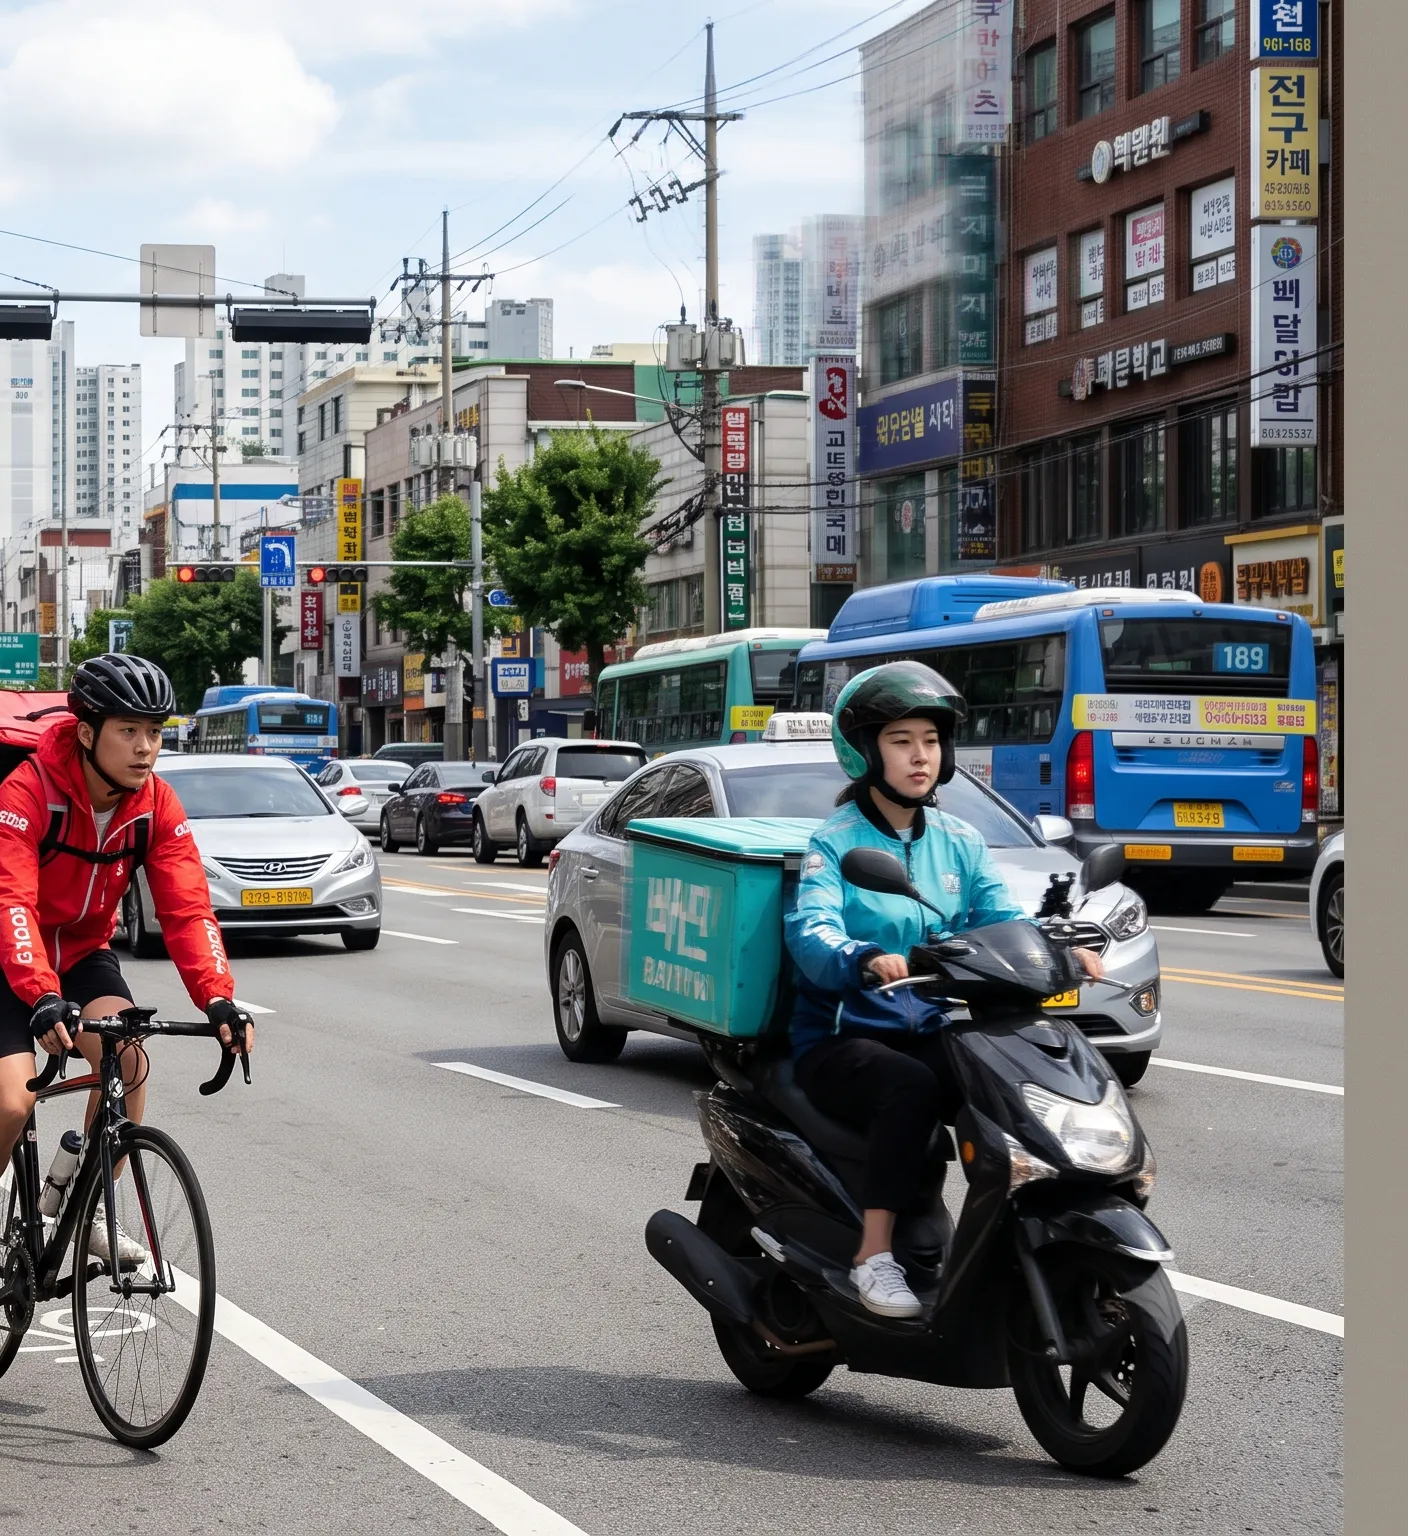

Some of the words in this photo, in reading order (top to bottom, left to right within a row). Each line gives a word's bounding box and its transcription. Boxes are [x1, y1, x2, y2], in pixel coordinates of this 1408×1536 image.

[1268, 75, 1308, 143] 전구
[1266, 149, 1310, 176] 카페
[1223, 645, 1264, 670] 189
